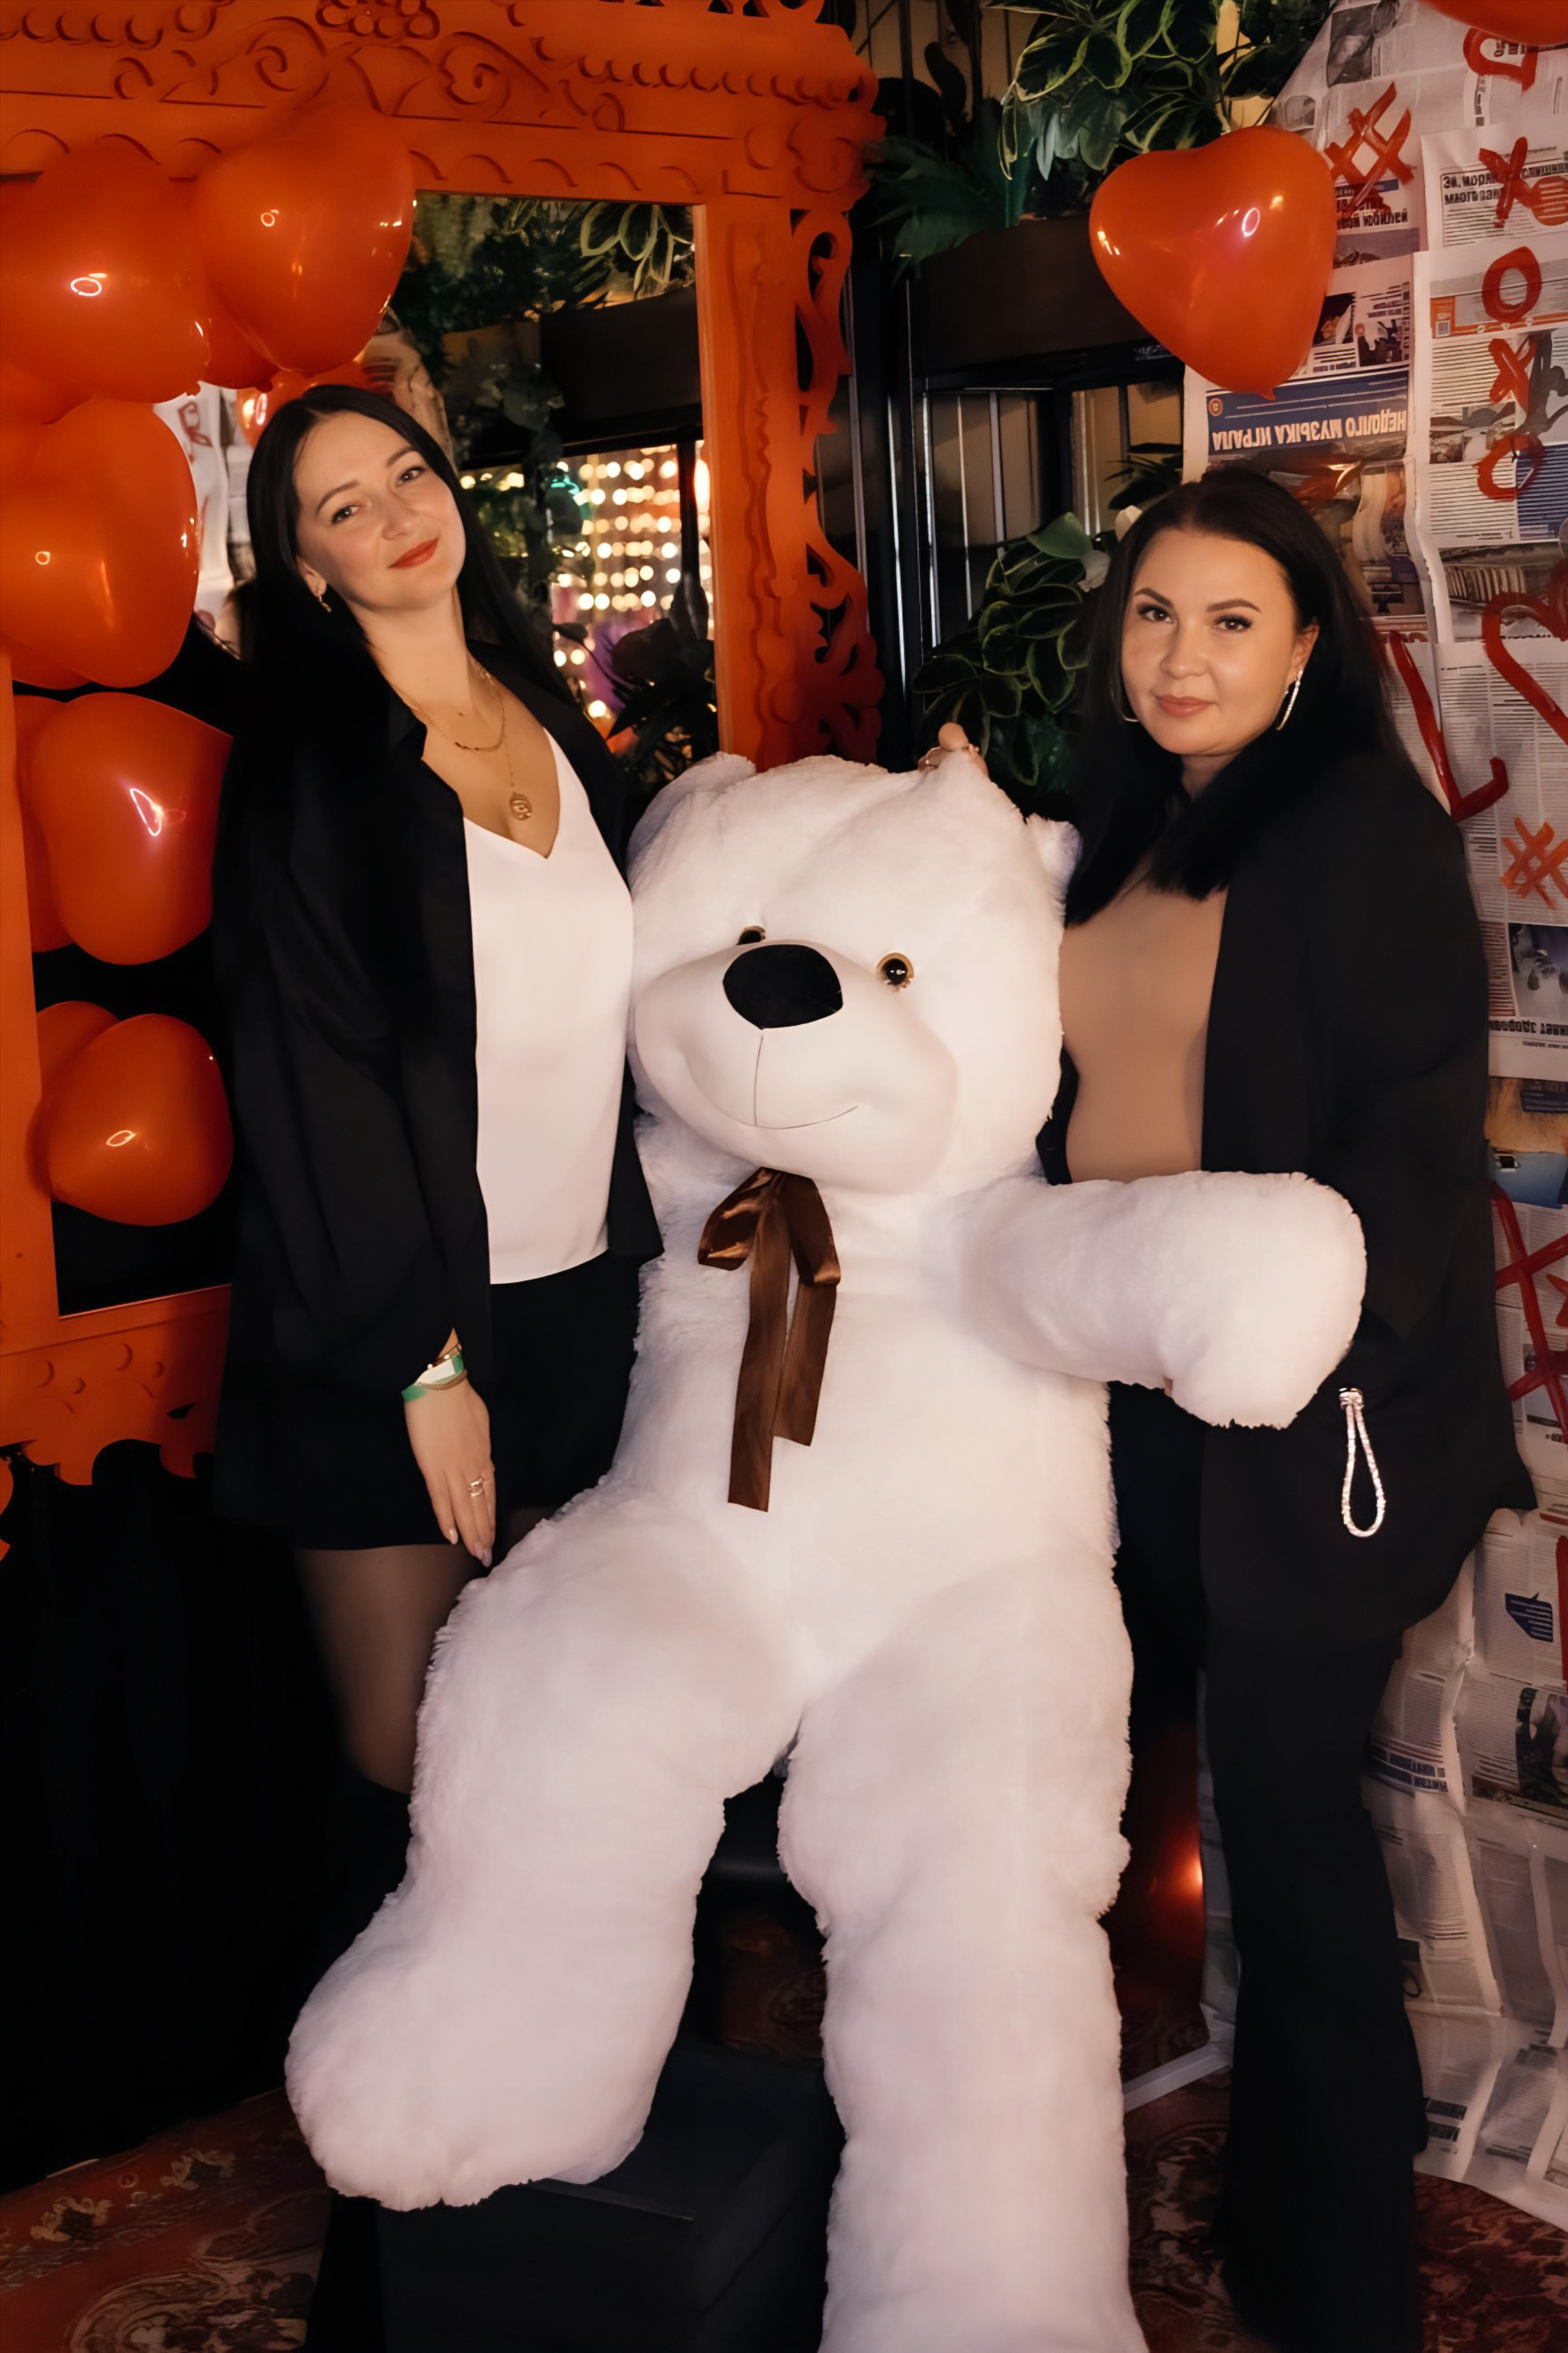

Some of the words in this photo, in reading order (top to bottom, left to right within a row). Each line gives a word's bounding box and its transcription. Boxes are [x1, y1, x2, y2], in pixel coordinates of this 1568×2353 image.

[1274, 418, 1343, 444] МУЗЫКА
[1345, 408, 1407, 437] НЕДОЛГО
[1212, 426, 1272, 451] ИГРАЛА
